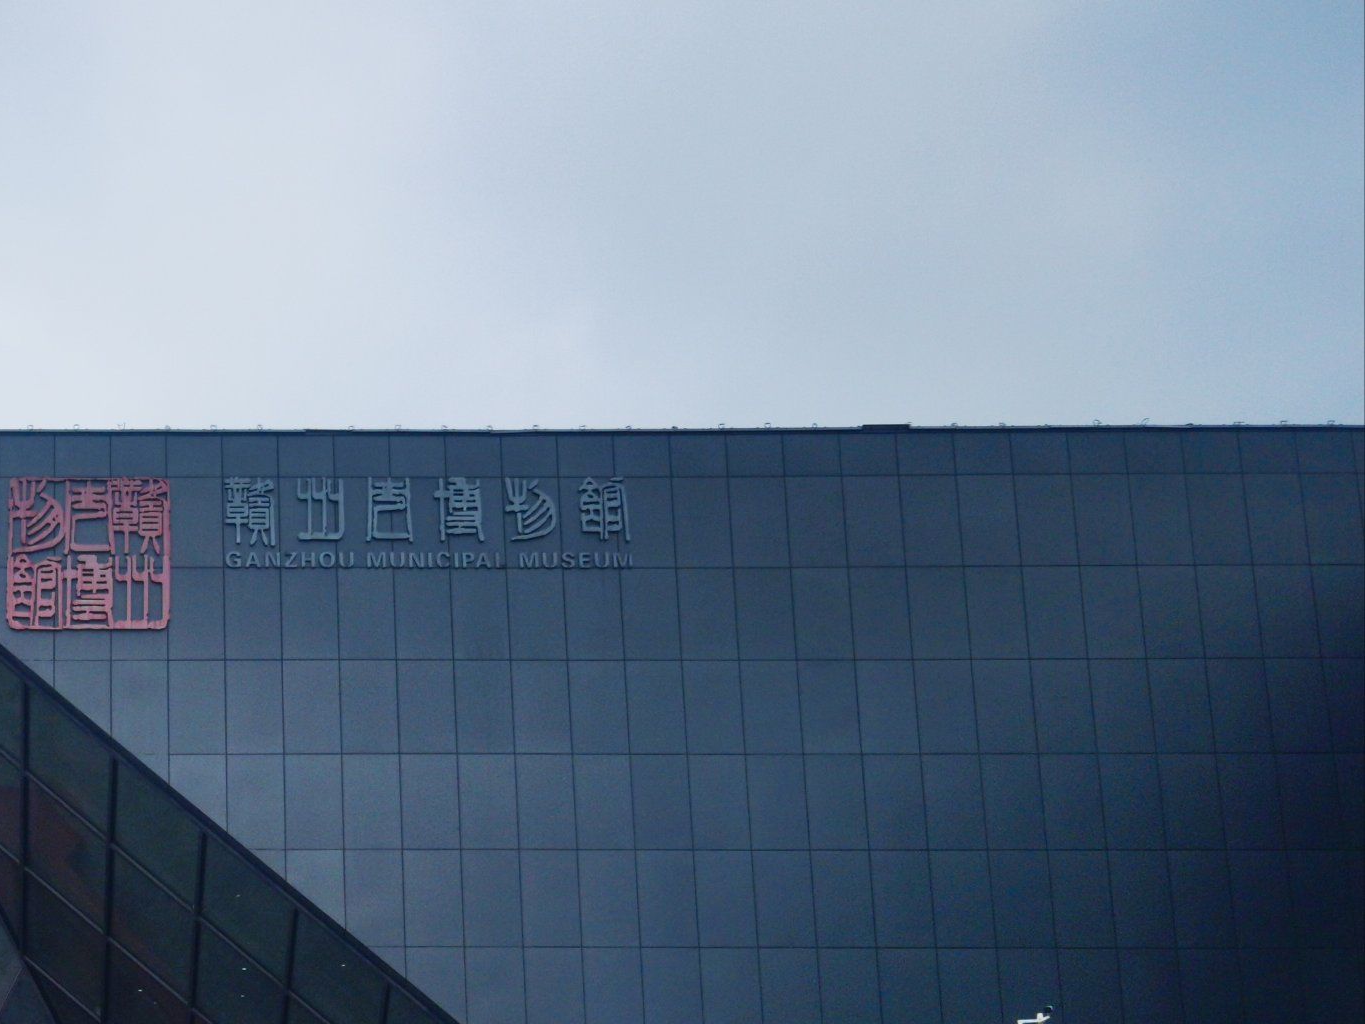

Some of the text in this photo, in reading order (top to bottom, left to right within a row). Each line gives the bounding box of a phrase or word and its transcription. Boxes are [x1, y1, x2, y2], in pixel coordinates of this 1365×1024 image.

[225, 551, 634, 569] GANZHOU MUNICIPAL MUSEUM
